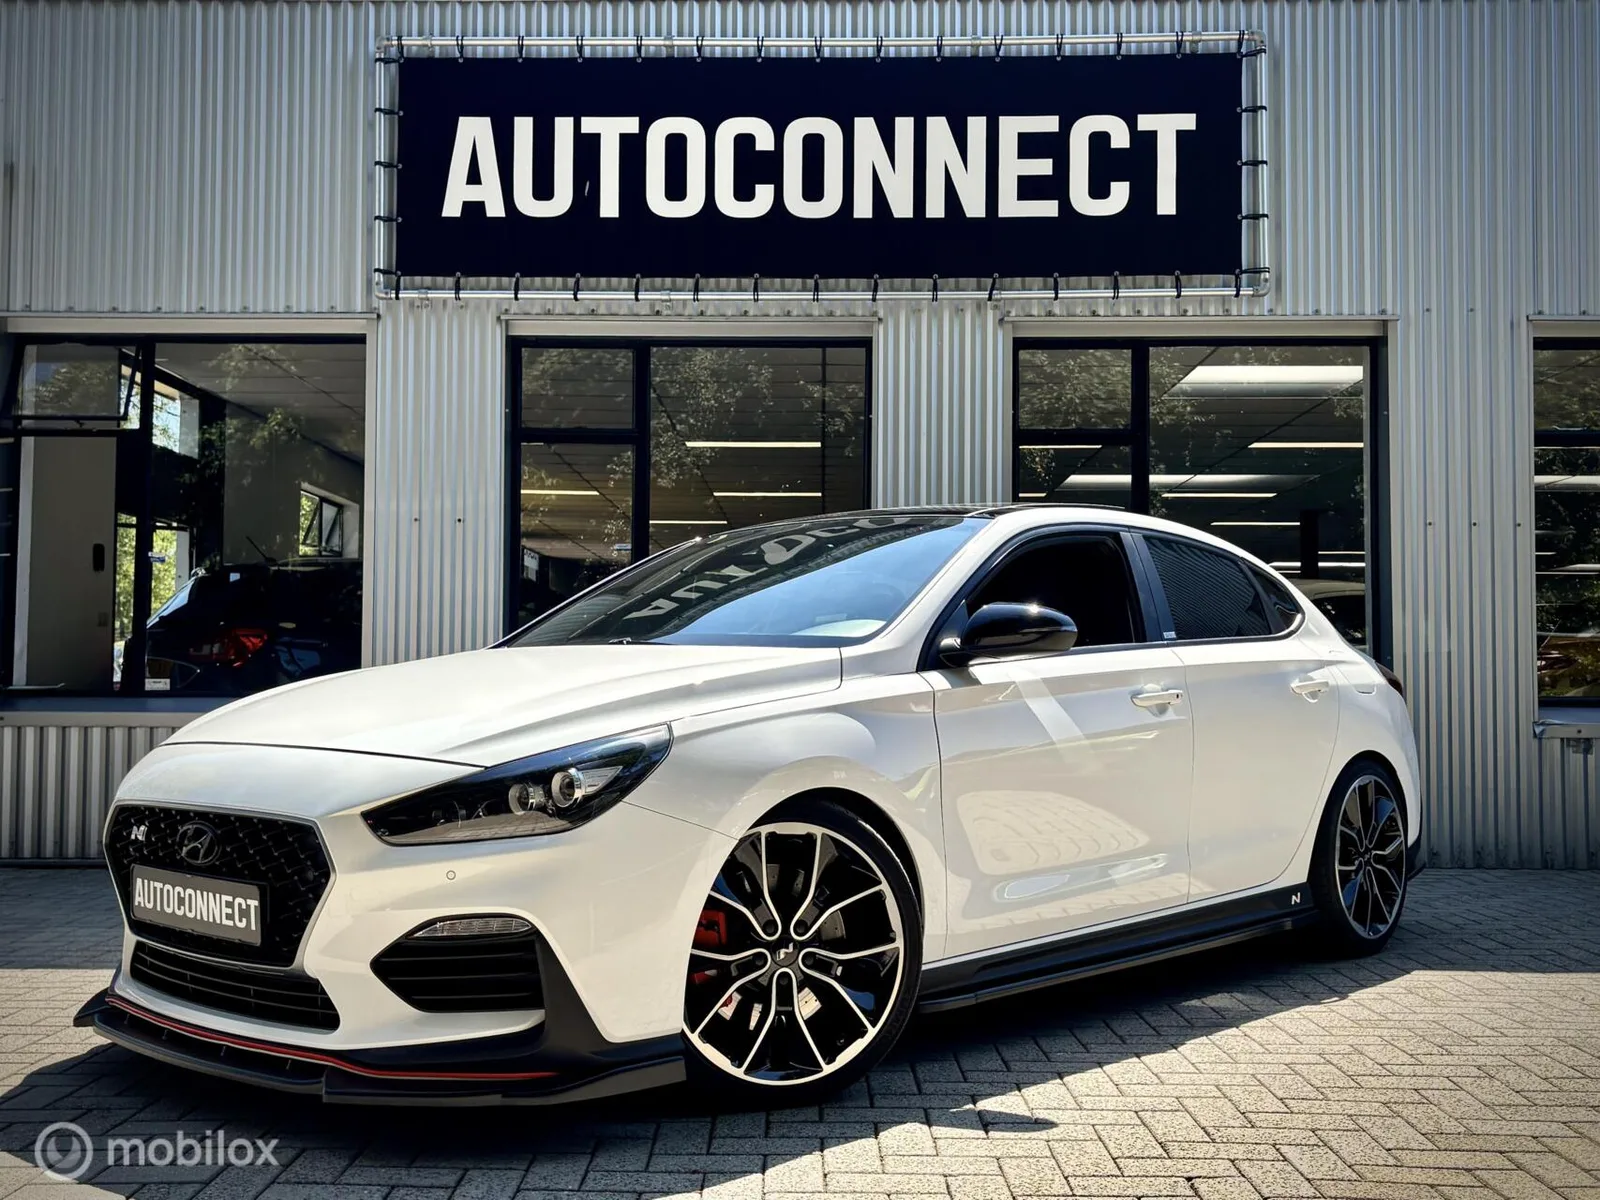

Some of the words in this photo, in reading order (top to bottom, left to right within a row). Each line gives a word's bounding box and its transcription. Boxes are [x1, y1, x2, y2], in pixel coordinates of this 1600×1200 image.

[441, 113, 1197, 219] AUTOCONNECT
[134, 877, 259, 931] AUTOCONNECT
[1291, 892, 1301, 905] N
